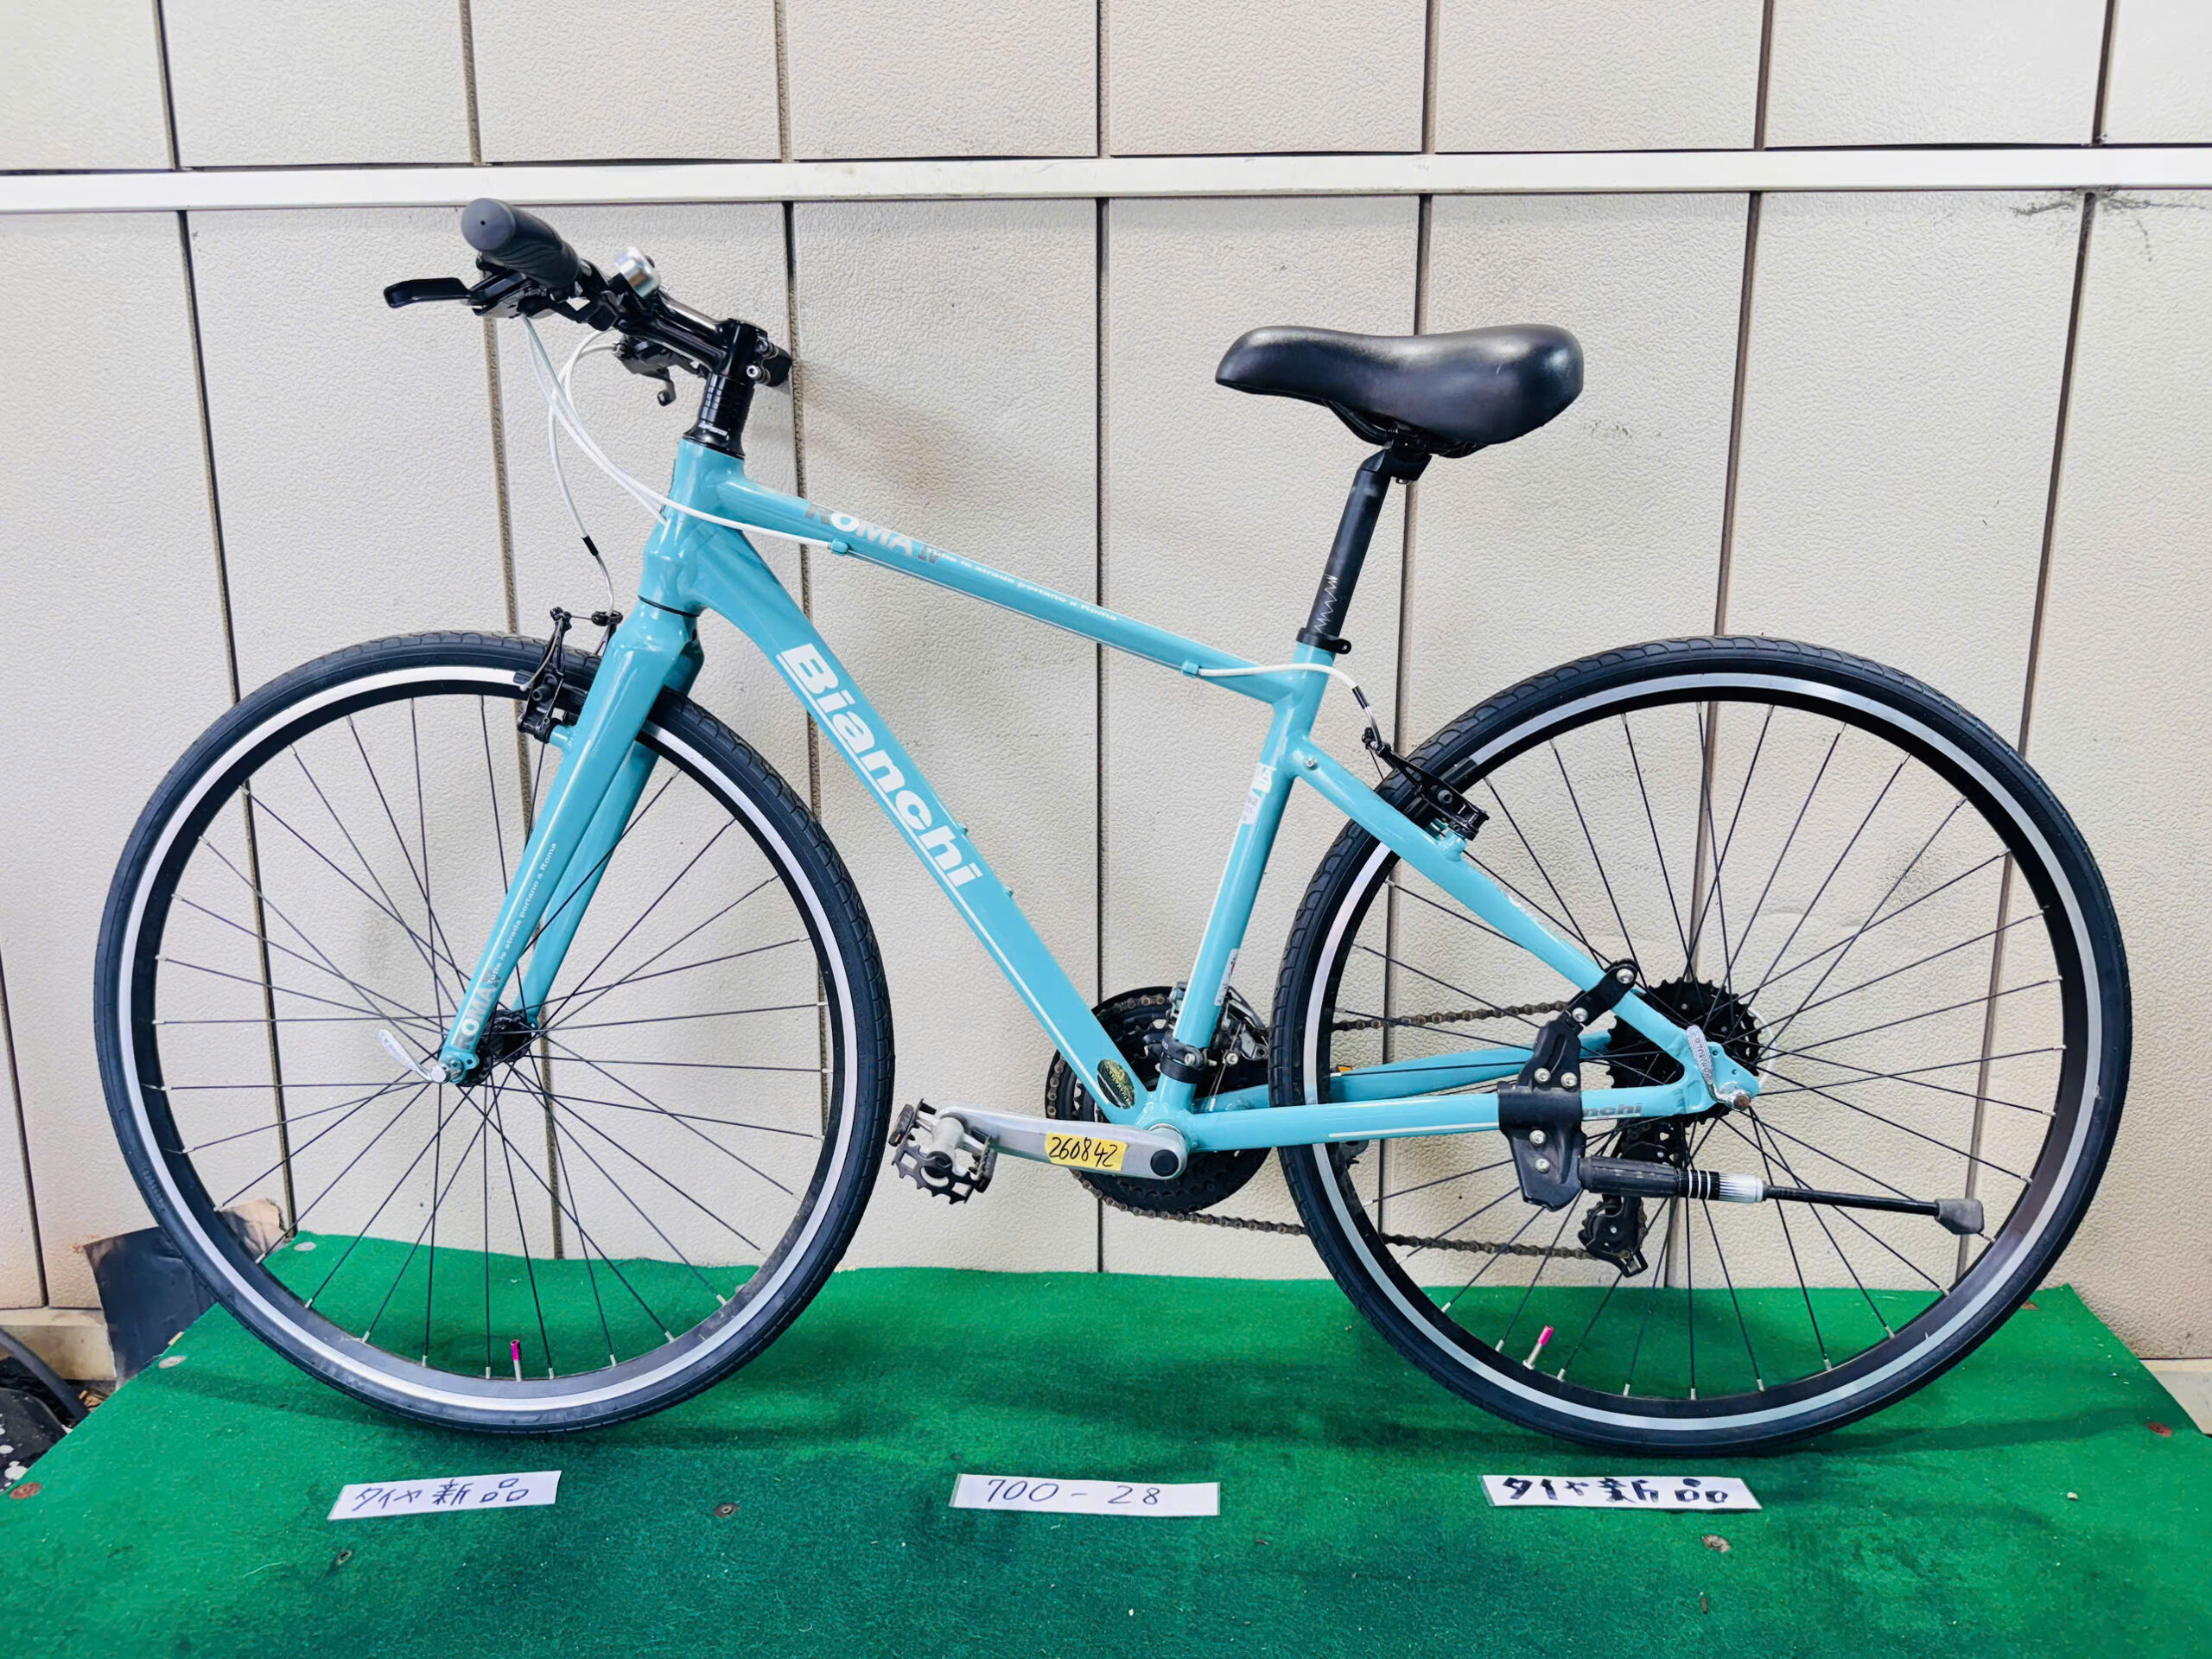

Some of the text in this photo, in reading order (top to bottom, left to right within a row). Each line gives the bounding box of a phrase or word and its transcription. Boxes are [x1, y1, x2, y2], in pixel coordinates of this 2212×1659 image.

[780, 642, 983, 887] Bianchi
[519, 881, 539, 918] portano
[540, 842, 557, 872] Roma
[1582, 1102, 1643, 1117] nchi
[1048, 1136, 1118, 1167] 260842
